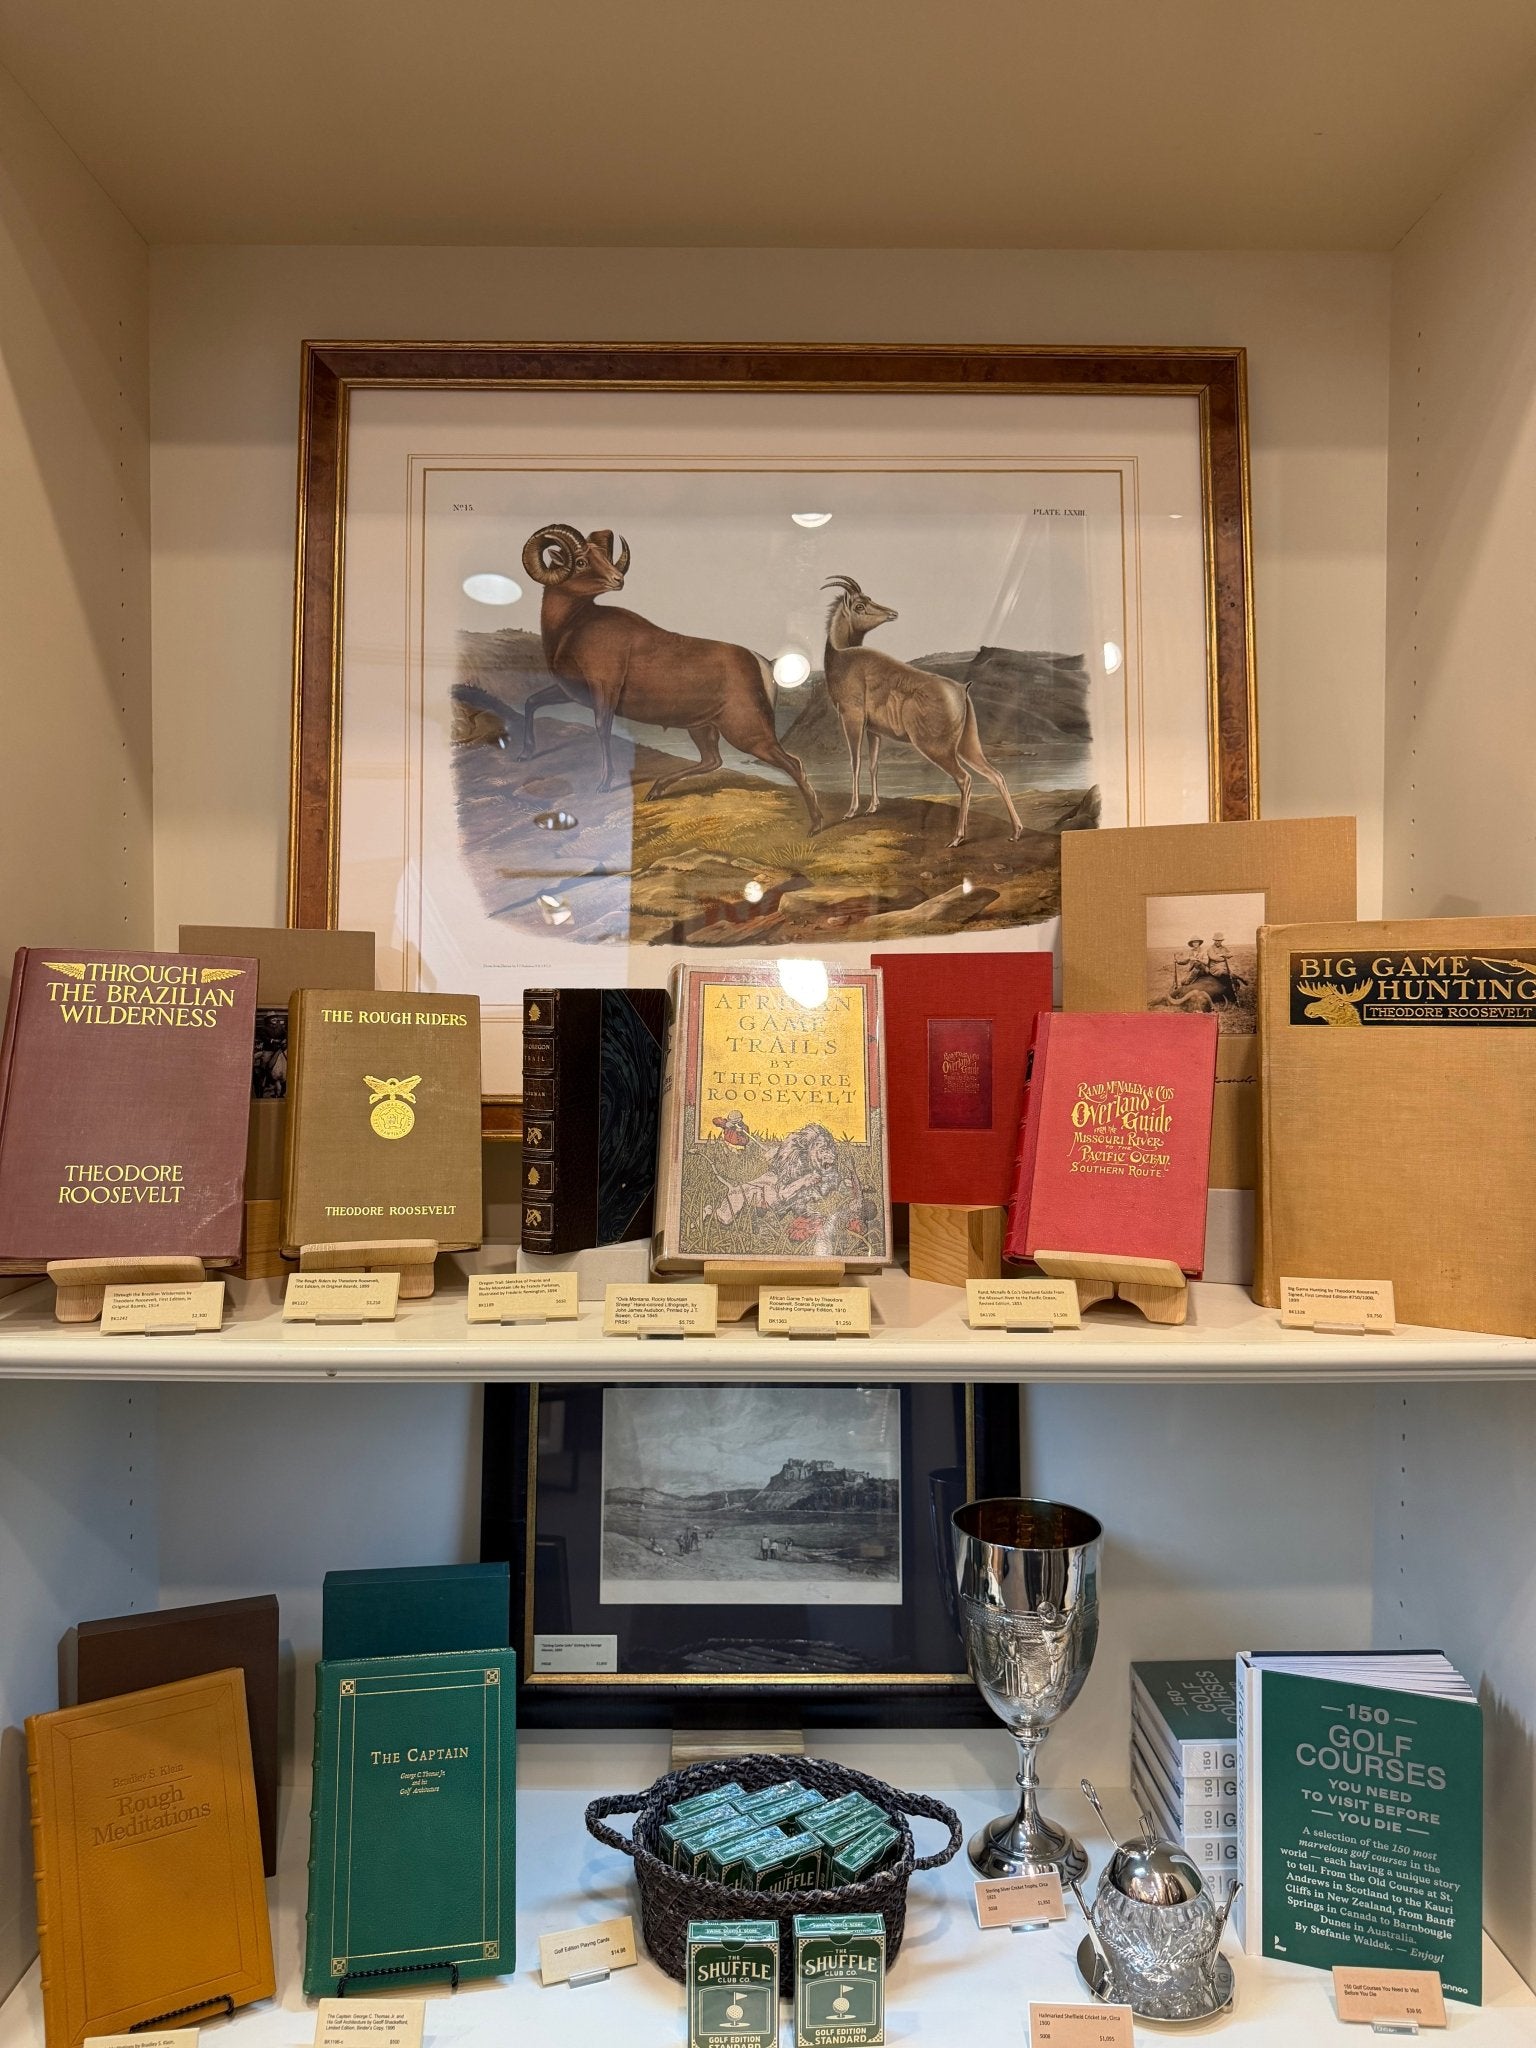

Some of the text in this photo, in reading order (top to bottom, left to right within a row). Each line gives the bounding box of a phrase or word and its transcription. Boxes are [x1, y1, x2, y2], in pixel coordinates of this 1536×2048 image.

[87, 963, 197, 985] THROUGH
[1300, 955, 1470, 978] BIG GAME
[47, 982, 235, 1008] THE BRAZILIAN
[1377, 979, 1536, 1001] HUNTING
[59, 1004, 217, 1028] WILDERNESS
[322, 1009, 468, 1026] THE ROUGH RIDERS
[1370, 1006, 1533, 1018] THEODORE ROOSEVELT
[739, 1014, 826, 1033] GAME
[726, 1036, 838, 1056] TRAILS
[770, 1060, 794, 1069] BY
[713, 1071, 851, 1087] THEODORE
[707, 1088, 857, 1105] ROOSEVELT
[1147, 1086, 1154, 1099] &
[1071, 1091, 1173, 1134] Overland Guide
[1074, 1131, 1164, 1149] MISSOURI RIVER
[1078, 1145, 1126, 1162] PACIFIC
[65, 1165, 184, 1182] THEODORE
[1069, 1162, 1124, 1175] SOUTHERN
[59, 1186, 185, 1204] ROOSEVELT
[325, 1205, 456, 1216] THEODORE ROOSEVELT
[1167, 1690, 1187, 1706] 150
[1182, 1682, 1218, 1713] GOLF
[1347, 1703, 1390, 1725] 150
[1329, 1724, 1413, 1758] GOLF
[371, 1747, 469, 1764] THE CAPTAIN
[1296, 1743, 1447, 1790] COURSES
[112, 1773, 147, 1789] Bradley
[160, 1763, 184, 1776] Klein
[117, 1784, 185, 1817] Rough
[1328, 1779, 1412, 1803] YOU NEED
[1301, 1789, 1441, 1825] TO VISIT BEFORE
[92, 1801, 211, 1847] Meditations
[1338, 1811, 1402, 1833] YOU DIE
[1302, 1826, 1438, 1860] A selection of the 150 most
[1298, 1839, 1441, 1874] marvelous golf courses in the
[1280, 1847, 1308, 1859] world
[1323, 1856, 1347, 1867] each
[1349, 1860, 1385, 1877] having
[1395, 1871, 1431, 1884] unique
[1433, 1879, 1461, 1892] story
[769, 1871, 814, 1892] HUFFLE
[1286, 1860, 1453, 1902] to tell. From the Old Course at St.
[1286, 1872, 1454, 1915] Andrews in Scotland to the Kauri
[1285, 1883, 1456, 1927] Cliffs in New Zealand, from Banff
[1287, 1896, 1452, 1940] Springs in Canada to Barnbougle
[1320, 1915, 1417, 1944] Dunes in Australia.
[564, 1944, 579, 1953] Edition
[580, 1940, 596, 1949] Playing
[596, 1936, 610, 1944] Cards
[1295, 1922, 1445, 1964] By Stefanie Waldek. Enjoy!
[697, 1961, 771, 1981] SHUFFLE
[805, 1954, 878, 1975] SHUFFLE
[1441, 1983, 1468, 1994] annoo
[815, 2035, 867, 2045] STANDARD
